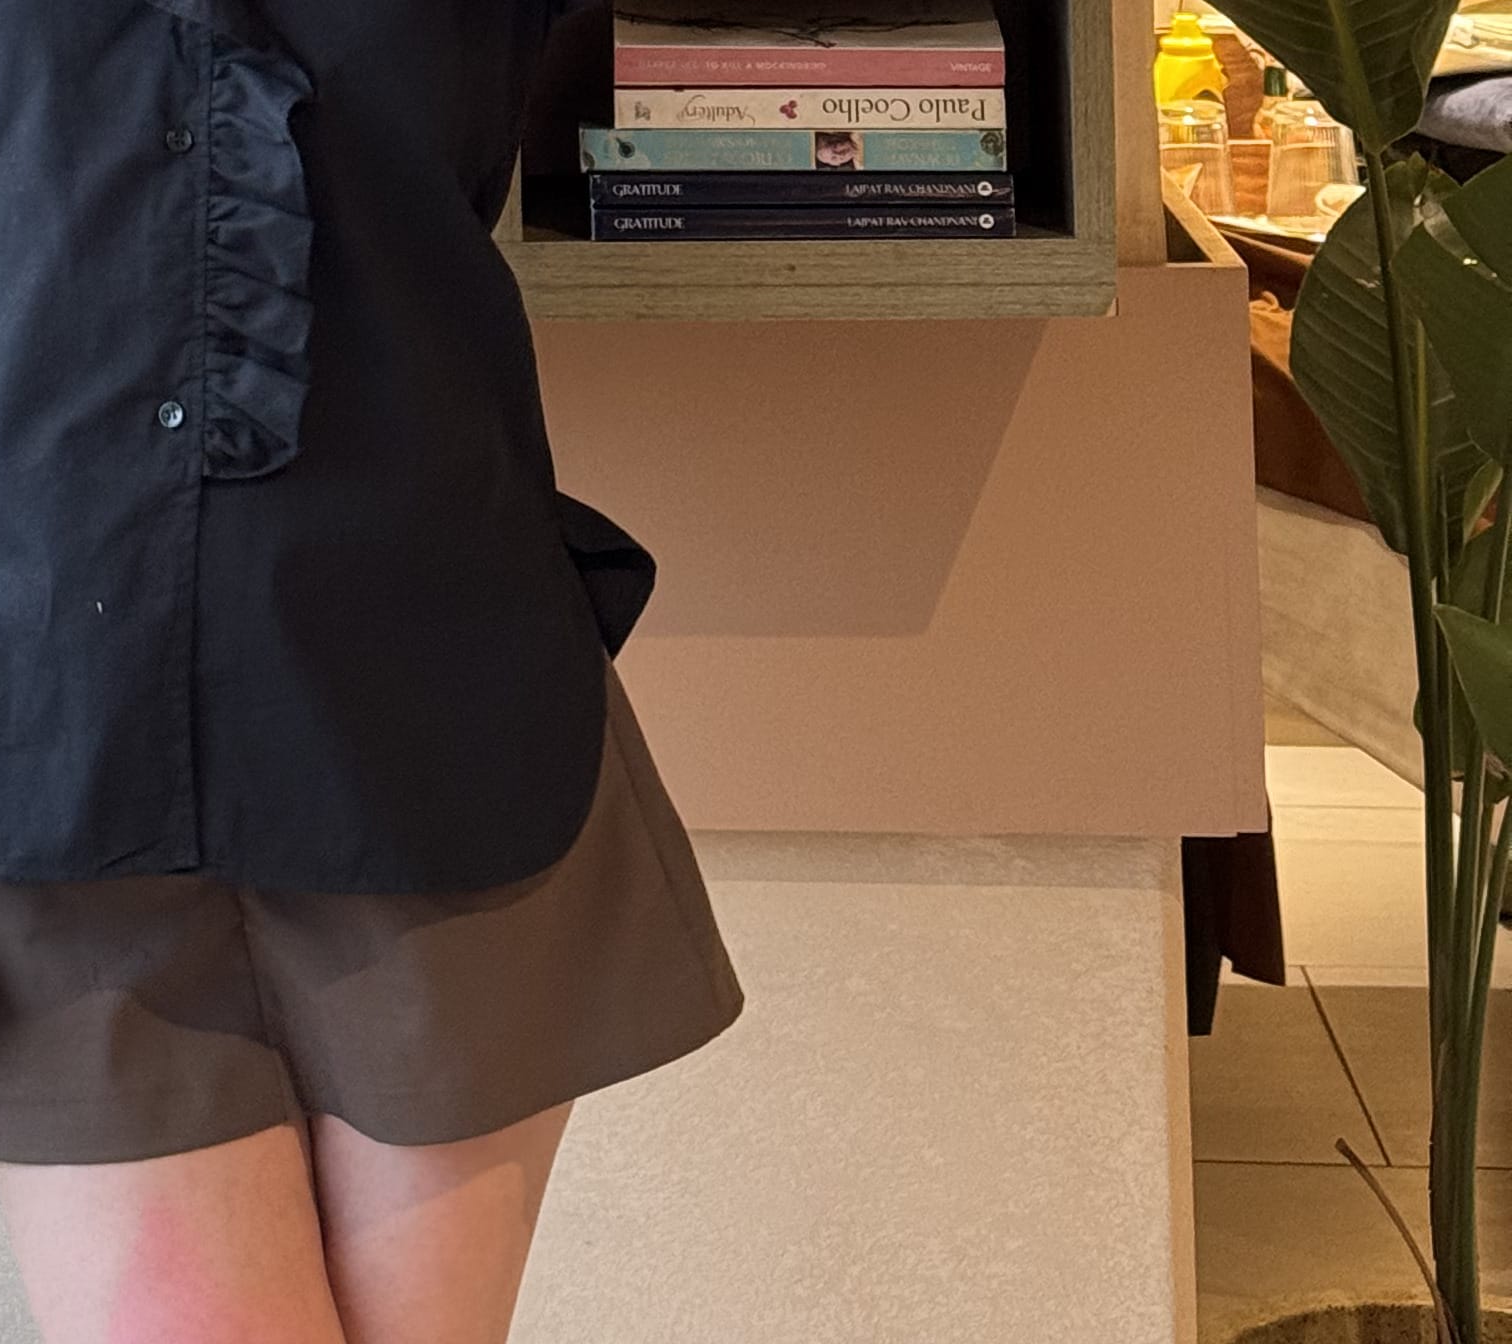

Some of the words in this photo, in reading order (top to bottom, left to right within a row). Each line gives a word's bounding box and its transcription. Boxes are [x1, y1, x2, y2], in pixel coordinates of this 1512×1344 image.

[822, 98, 910, 122] Coelho
[918, 98, 987, 121] Paulo
[612, 183, 684, 197] GRATITUDE
[614, 217, 686, 230] GRATITUDE
